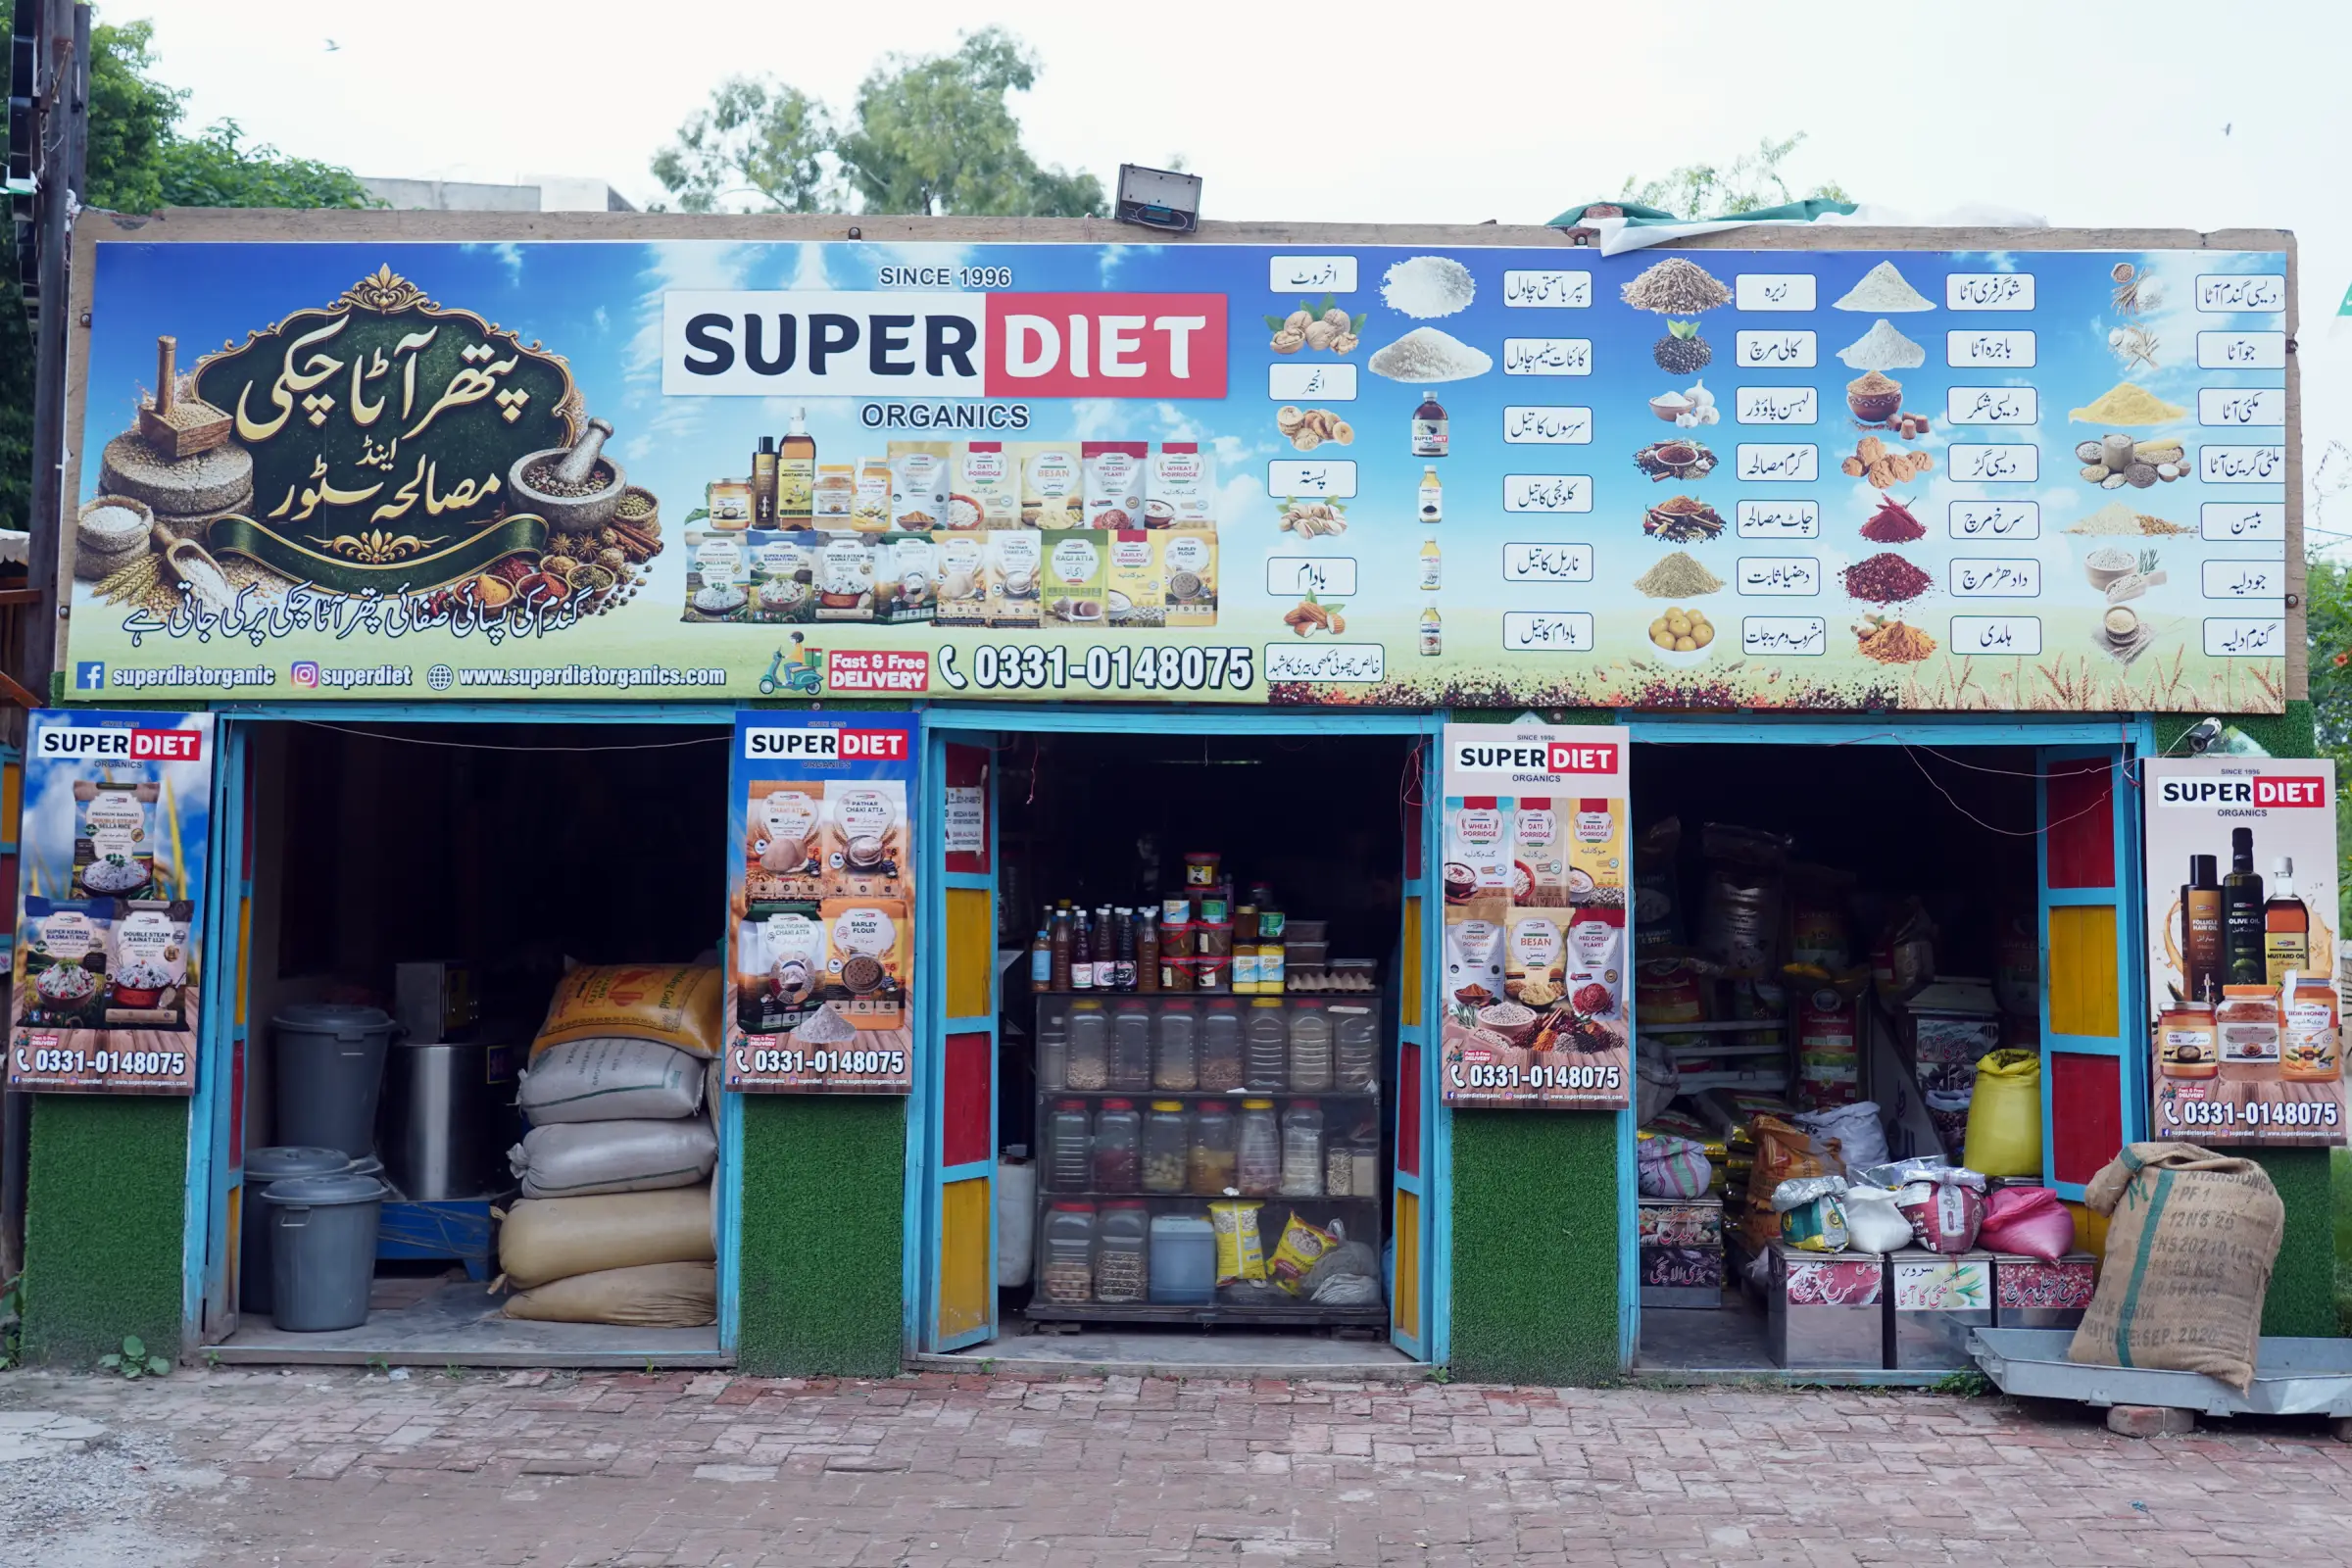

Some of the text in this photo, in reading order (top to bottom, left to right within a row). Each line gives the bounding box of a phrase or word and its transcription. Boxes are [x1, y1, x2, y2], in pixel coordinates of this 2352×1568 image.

[880, 267, 1012, 287] SINCE 1996
[1291, 264, 1337, 285] اخروٹ
[1507, 274, 1588, 303] سپر باسمتی چاول
[1764, 283, 1788, 302] زیرہ
[1960, 275, 2021, 304] شوگر فری آٹا
[2205, 279, 2277, 307] دیسی گندم آٹا
[683, 313, 1206, 379] SUPER DIET
[1507, 341, 1589, 372] کائنات سٹیم چاول
[1750, 337, 1803, 362] کالی مرچ
[1971, 337, 2012, 359] باجرہ آٹا
[2228, 339, 2256, 361] جو آٹا
[236, 314, 530, 442] پتھر آٹا چکی
[1301, 369, 1325, 395] انجیر
[860, 403, 1031, 429] ORGANICS
[1778, 390, 1810, 420] لہسن
[1967, 392, 2020, 420] دیسی شکر
[2223, 392, 2264, 423] مکئی آٹا
[1511, 412, 1586, 438] سرسوں کا تیل
[356, 434, 398, 470] اینڈ
[1746, 448, 1809, 476] گرم مصالحہ
[1972, 448, 2016, 477] دیسی گڑ
[2210, 446, 2279, 477] ملٹی گرین آٹا
[268, 453, 502, 524] مصالحہ سٹور
[1299, 468, 1327, 490] پستہ
[1518, 479, 1578, 508] کلونجی کا تیل
[1742, 506, 1813, 534] چاٹ مصالحہ
[1964, 507, 2025, 534] سرخ مرچ
[2230, 511, 2262, 535] بیسن
[1518, 548, 1579, 576] ناریل کا تیل
[1298, 563, 1327, 590] بادام
[1747, 564, 1810, 588] دھنیا ثابت
[1963, 569, 1993, 590] مرچ
[2229, 569, 2267, 595] جو دلیہ
[122, 579, 596, 647] گندم کی پسائی صفائی پتھر آٹا چکی پر کی جاتی ہے
[1521, 618, 1576, 644] بادام کا تیل
[1745, 625, 1770, 647] جات
[1788, 622, 1823, 650] مشروب
[1980, 623, 2012, 648] ہلدی
[2221, 622, 2277, 652] گندم دلیہ
[830, 653, 926, 671] Fast & Free
[974, 645, 1255, 691] 0331-0148075
[1269, 656, 1287, 676] شہد
[1286, 656, 1296, 673] کا
[1292, 658, 1311, 676] بیری
[1312, 648, 1337, 676] مکھی
[1353, 655, 1380, 676] خالص
[112, 664, 276, 690] superdietorganic
[320, 664, 414, 690] superdiet
[459, 663, 726, 690] www.superdietorganics.com
[830, 670, 926, 690] DELIVERY
[44, 733, 196, 756] SUPER DIET
[752, 734, 903, 756] SUPER DIET
[94, 760, 143, 769] ORGANICS
[802, 760, 851, 769] ORGANICS
[1460, 748, 1613, 769] SUPER DIET
[1512, 774, 1562, 783] ORGANICS
[2164, 782, 2320, 804] SUPER DIET
[2217, 808, 2268, 817] ORGANICS
[1520, 937, 1552, 947] BESAN
[35, 1049, 186, 1075] 0331-0148075
[755, 1050, 905, 1074] 0331-0148075
[1470, 1064, 1620, 1089] 0331-0148075
[2183, 1102, 2338, 1127] 0331-0148075
[1824, 1271, 1857, 1304] سرخ
